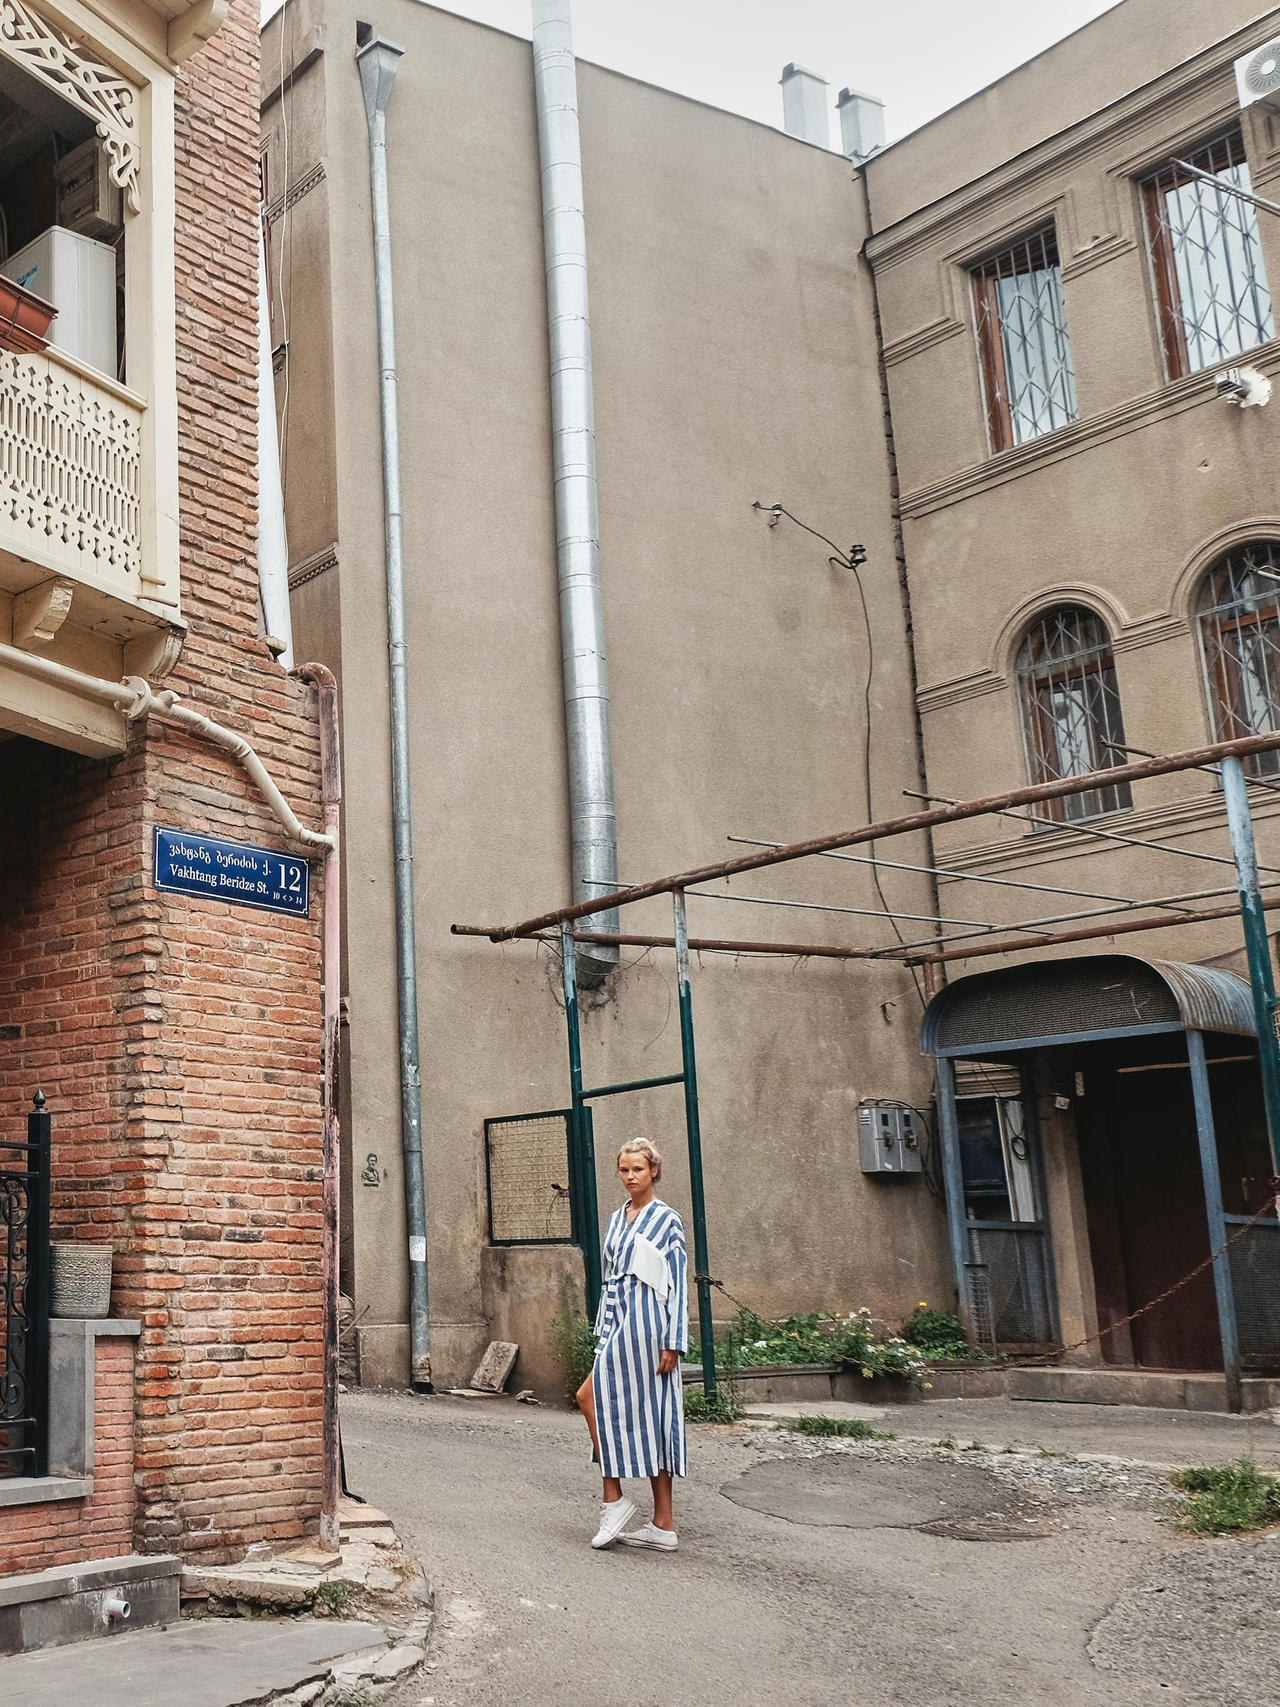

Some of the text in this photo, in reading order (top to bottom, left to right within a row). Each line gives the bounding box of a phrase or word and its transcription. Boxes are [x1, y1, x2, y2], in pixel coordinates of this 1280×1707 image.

[169, 842, 272, 876] ვახტანგ ბერიძის ქ.
[169, 863, 269, 895] Vakhtang Beridze St.
[278, 863, 301, 892] 12
[272, 891, 303, 905] 10 14
